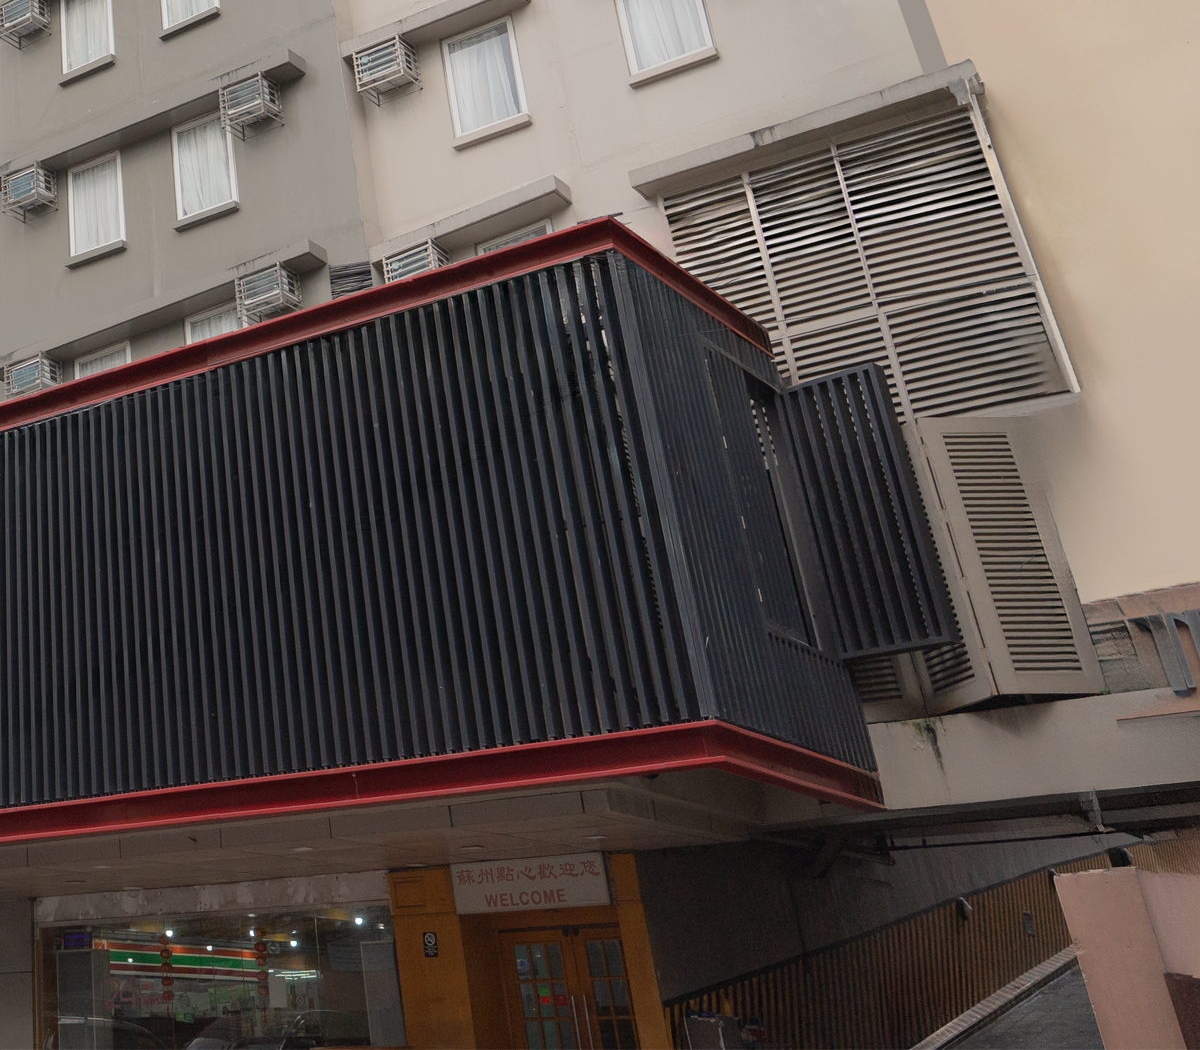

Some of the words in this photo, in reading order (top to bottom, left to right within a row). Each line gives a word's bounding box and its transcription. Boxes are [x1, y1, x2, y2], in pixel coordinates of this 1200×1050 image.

[456, 859, 601, 886] 蘇州點心歡迎您
[484, 888, 567, 908] WELCOME
